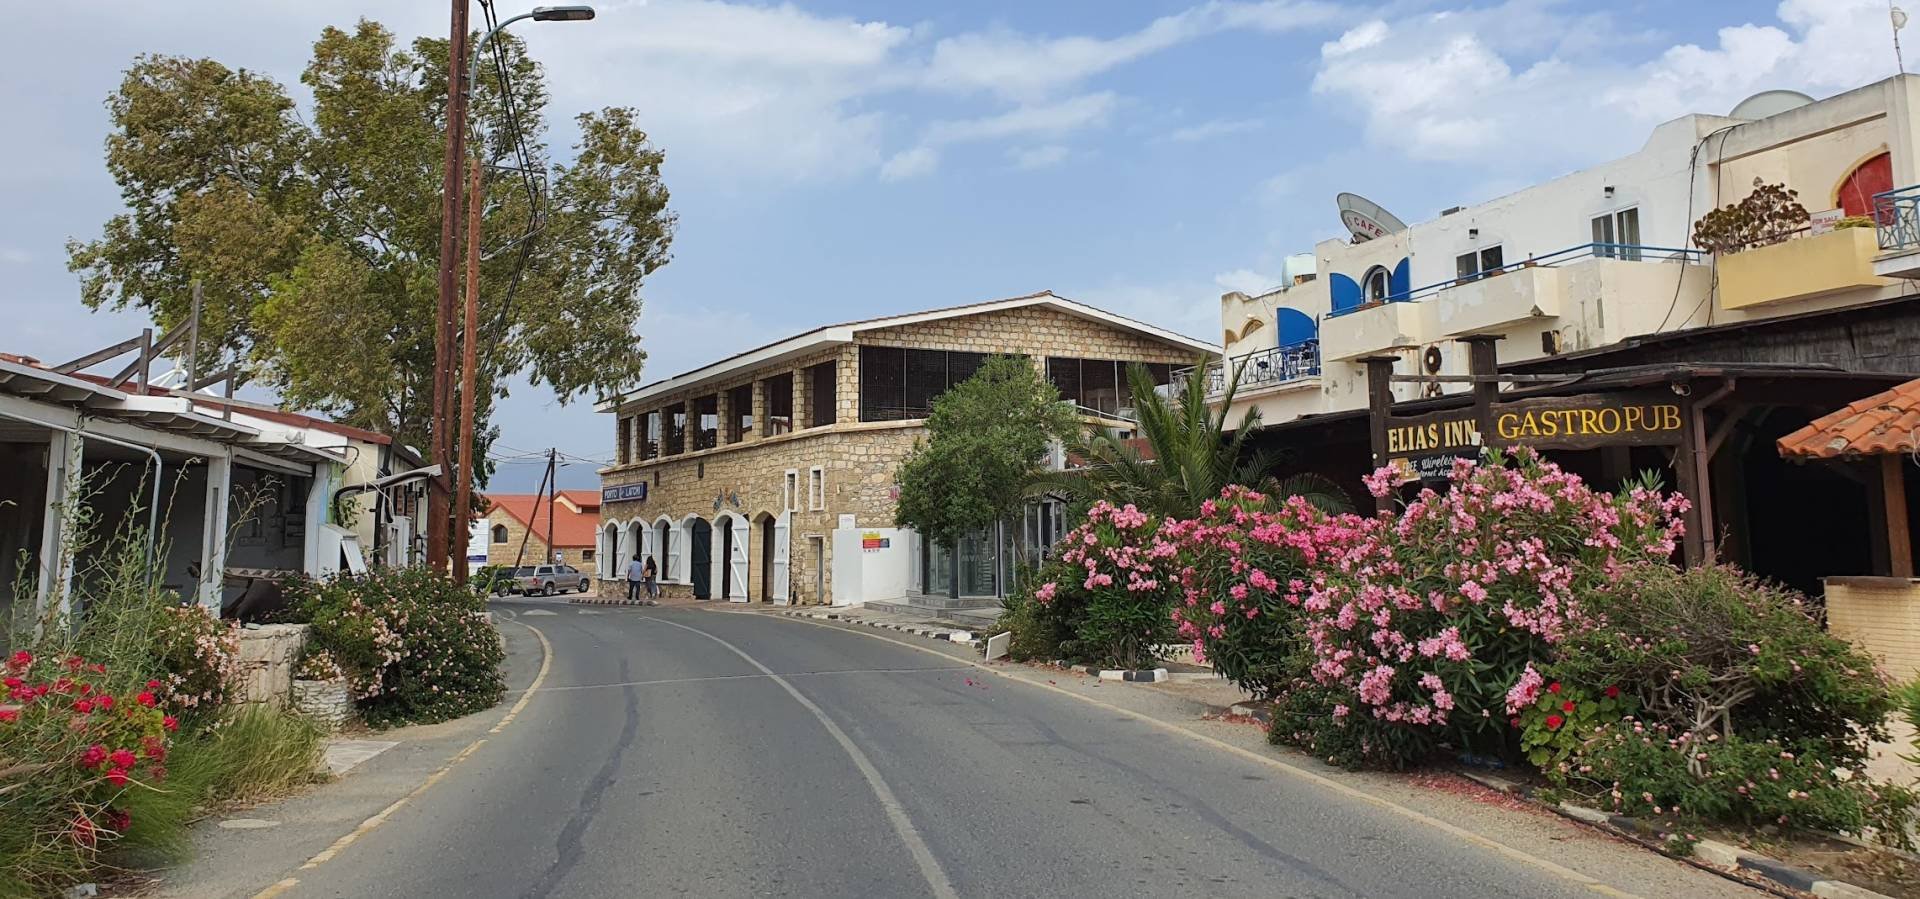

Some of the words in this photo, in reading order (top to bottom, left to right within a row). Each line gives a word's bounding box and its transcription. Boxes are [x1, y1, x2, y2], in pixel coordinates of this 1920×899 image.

[1353, 217, 1383, 237] CAFE
[1388, 423, 1439, 453] ELIAS
[1443, 419, 1476, 447] INN
[604, 489, 618, 499] PORTO
